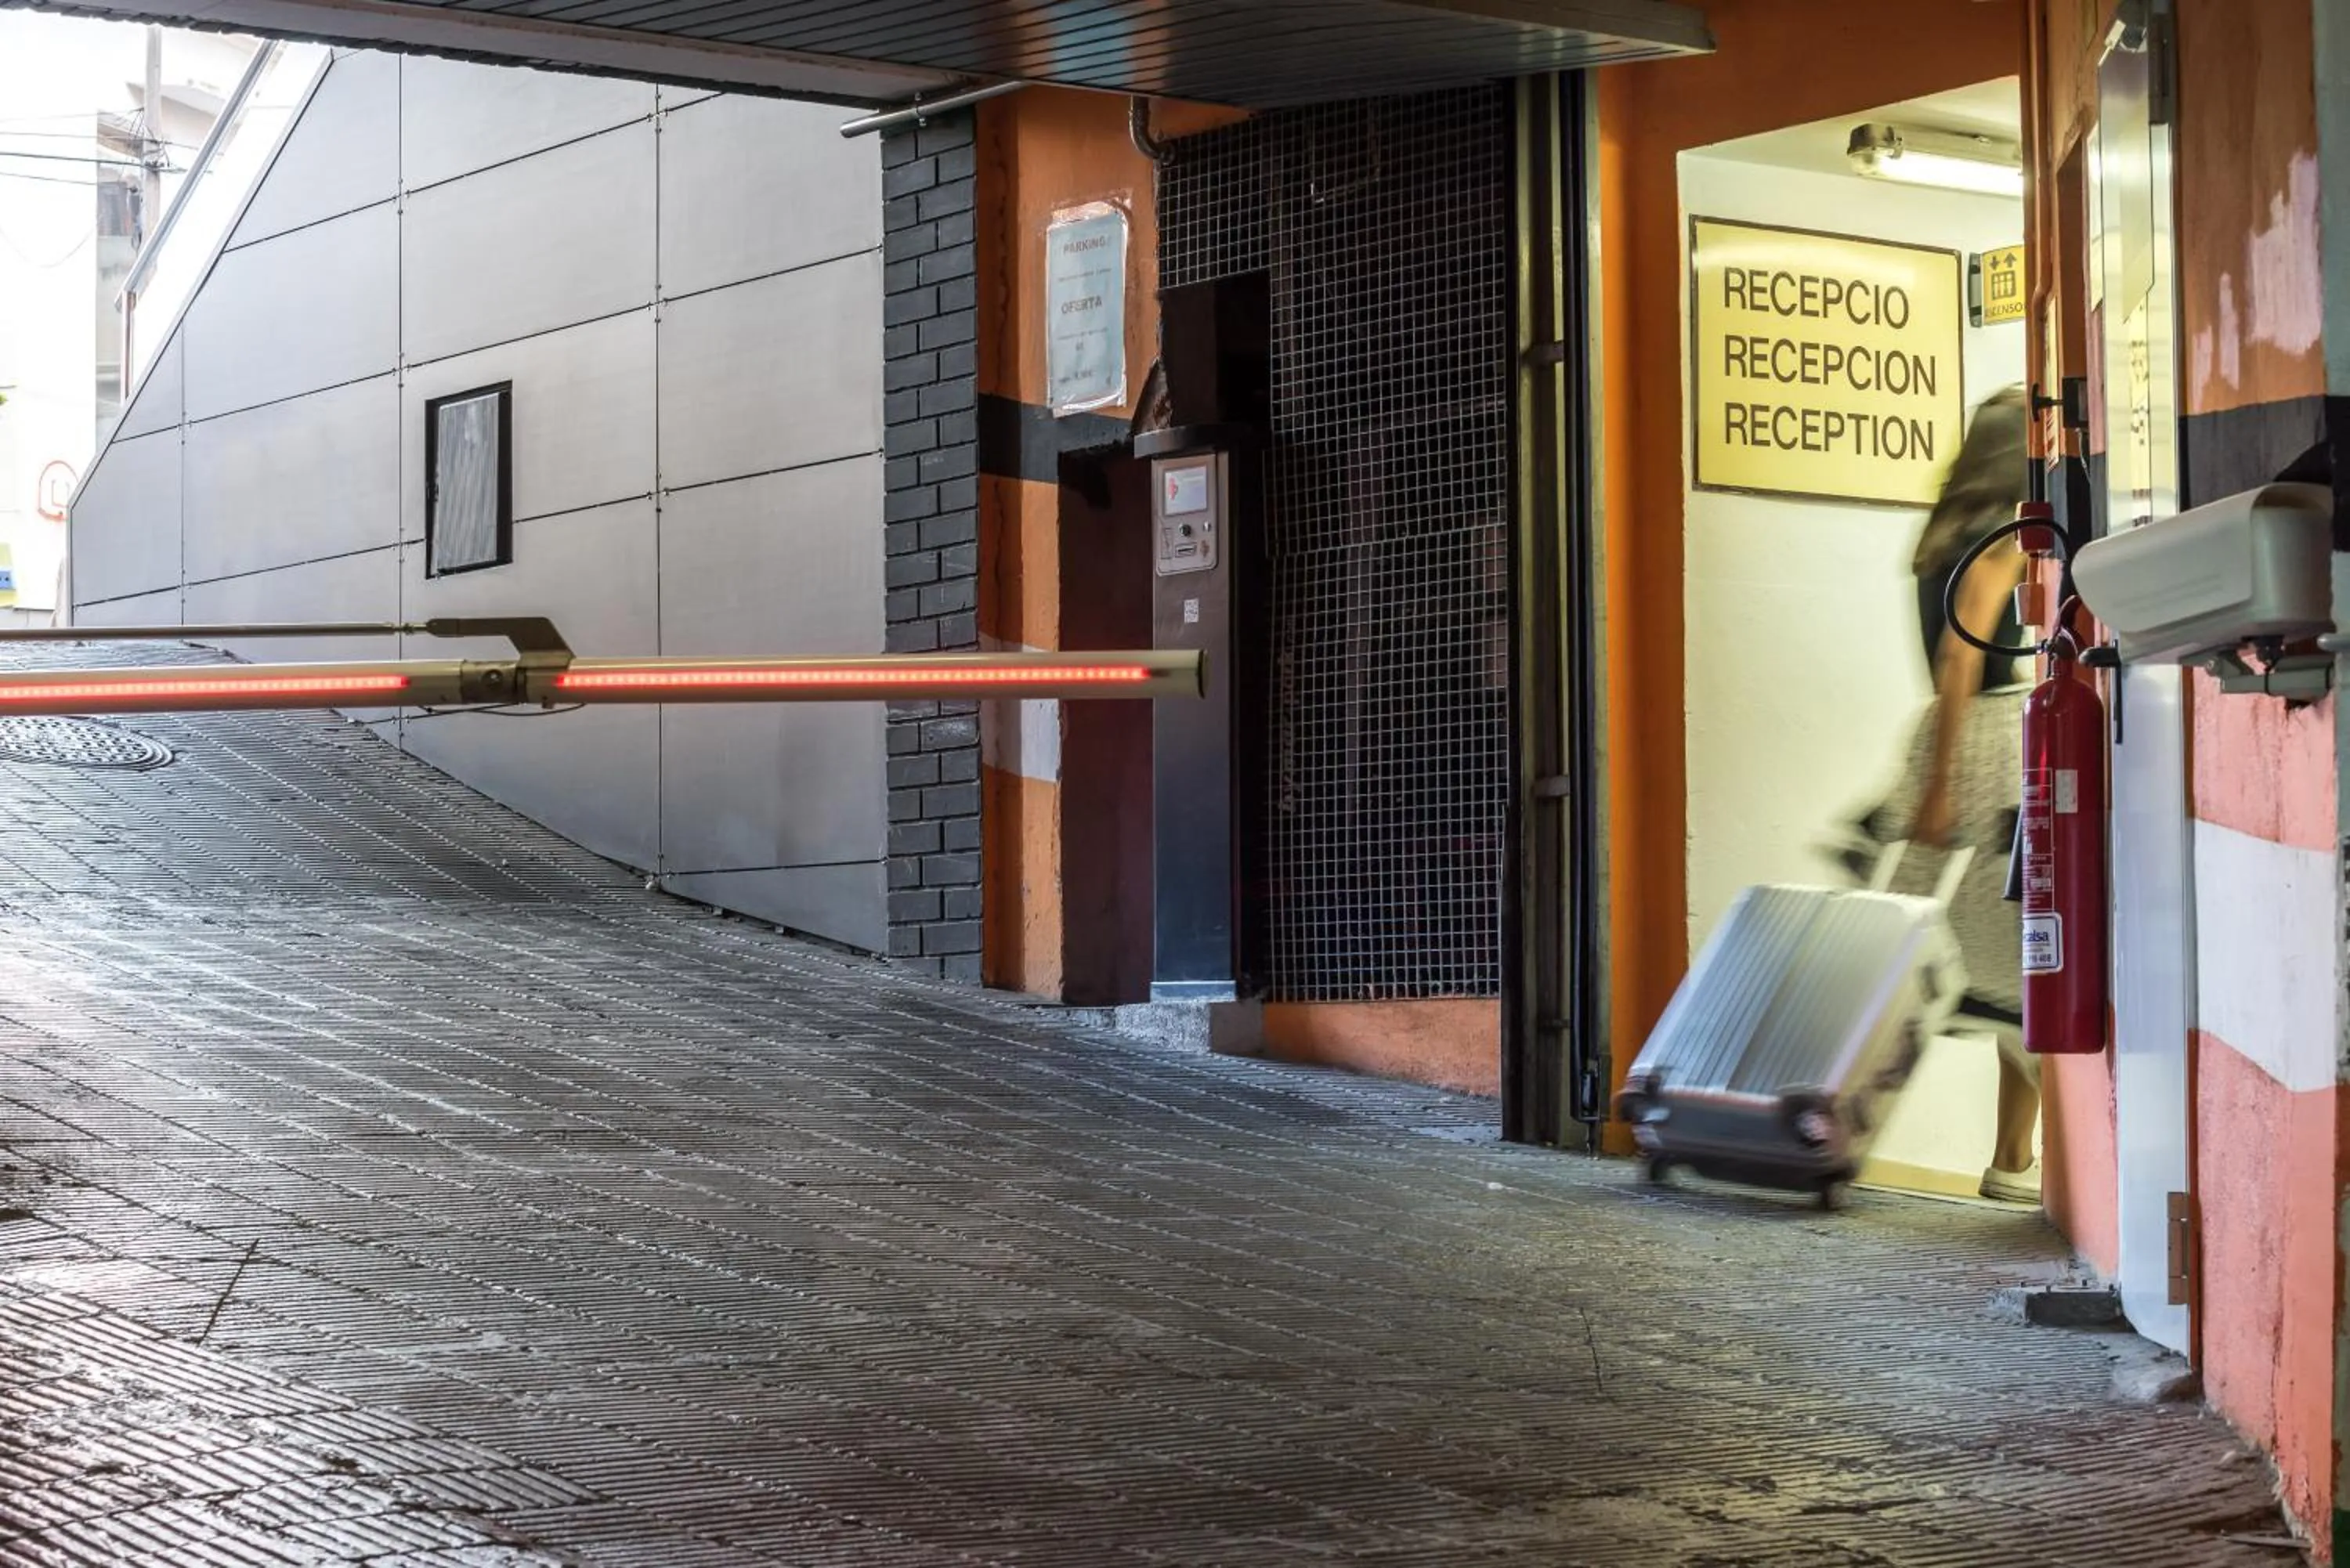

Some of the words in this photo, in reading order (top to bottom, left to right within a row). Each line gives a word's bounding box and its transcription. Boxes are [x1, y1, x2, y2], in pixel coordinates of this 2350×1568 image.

[1063, 236, 1105, 253] PARKING
[1061, 295, 1102, 313] OFERTA
[1724, 267, 1909, 329] RECEPCIO
[1724, 335, 1936, 396] RECEPCION
[1725, 403, 1933, 461] RECEPTION
